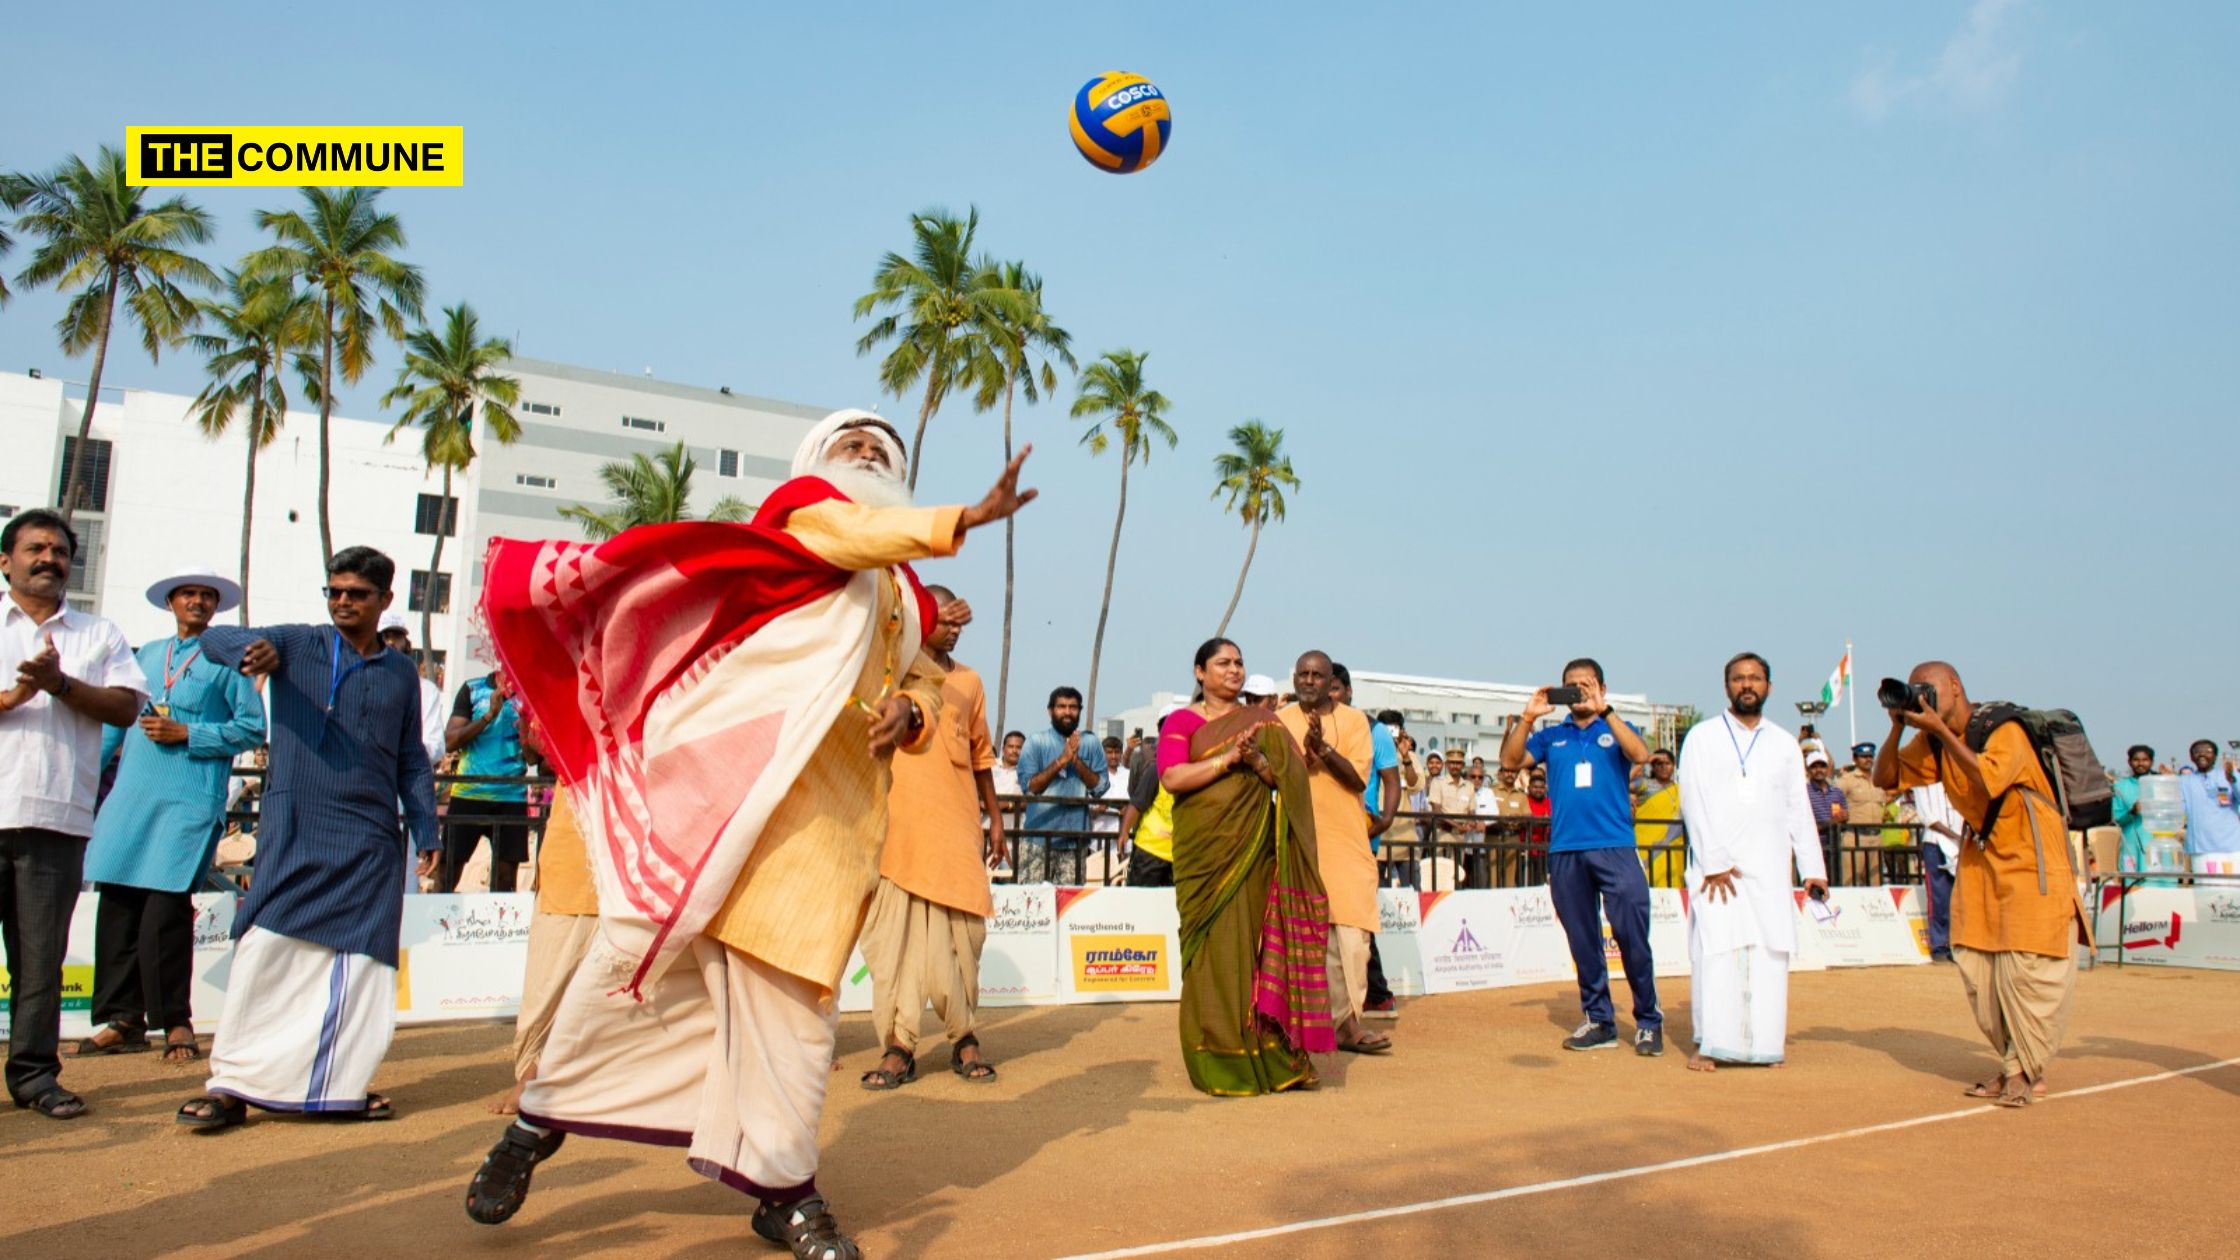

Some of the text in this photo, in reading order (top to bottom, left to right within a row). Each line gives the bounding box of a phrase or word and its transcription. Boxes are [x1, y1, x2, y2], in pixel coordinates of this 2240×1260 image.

[1107, 83, 1159, 110] COSCO
[1069, 922, 1136, 933] Strengthened By
[2122, 921, 2154, 935] Hello
[1086, 947, 1158, 963] ராம்கோ
